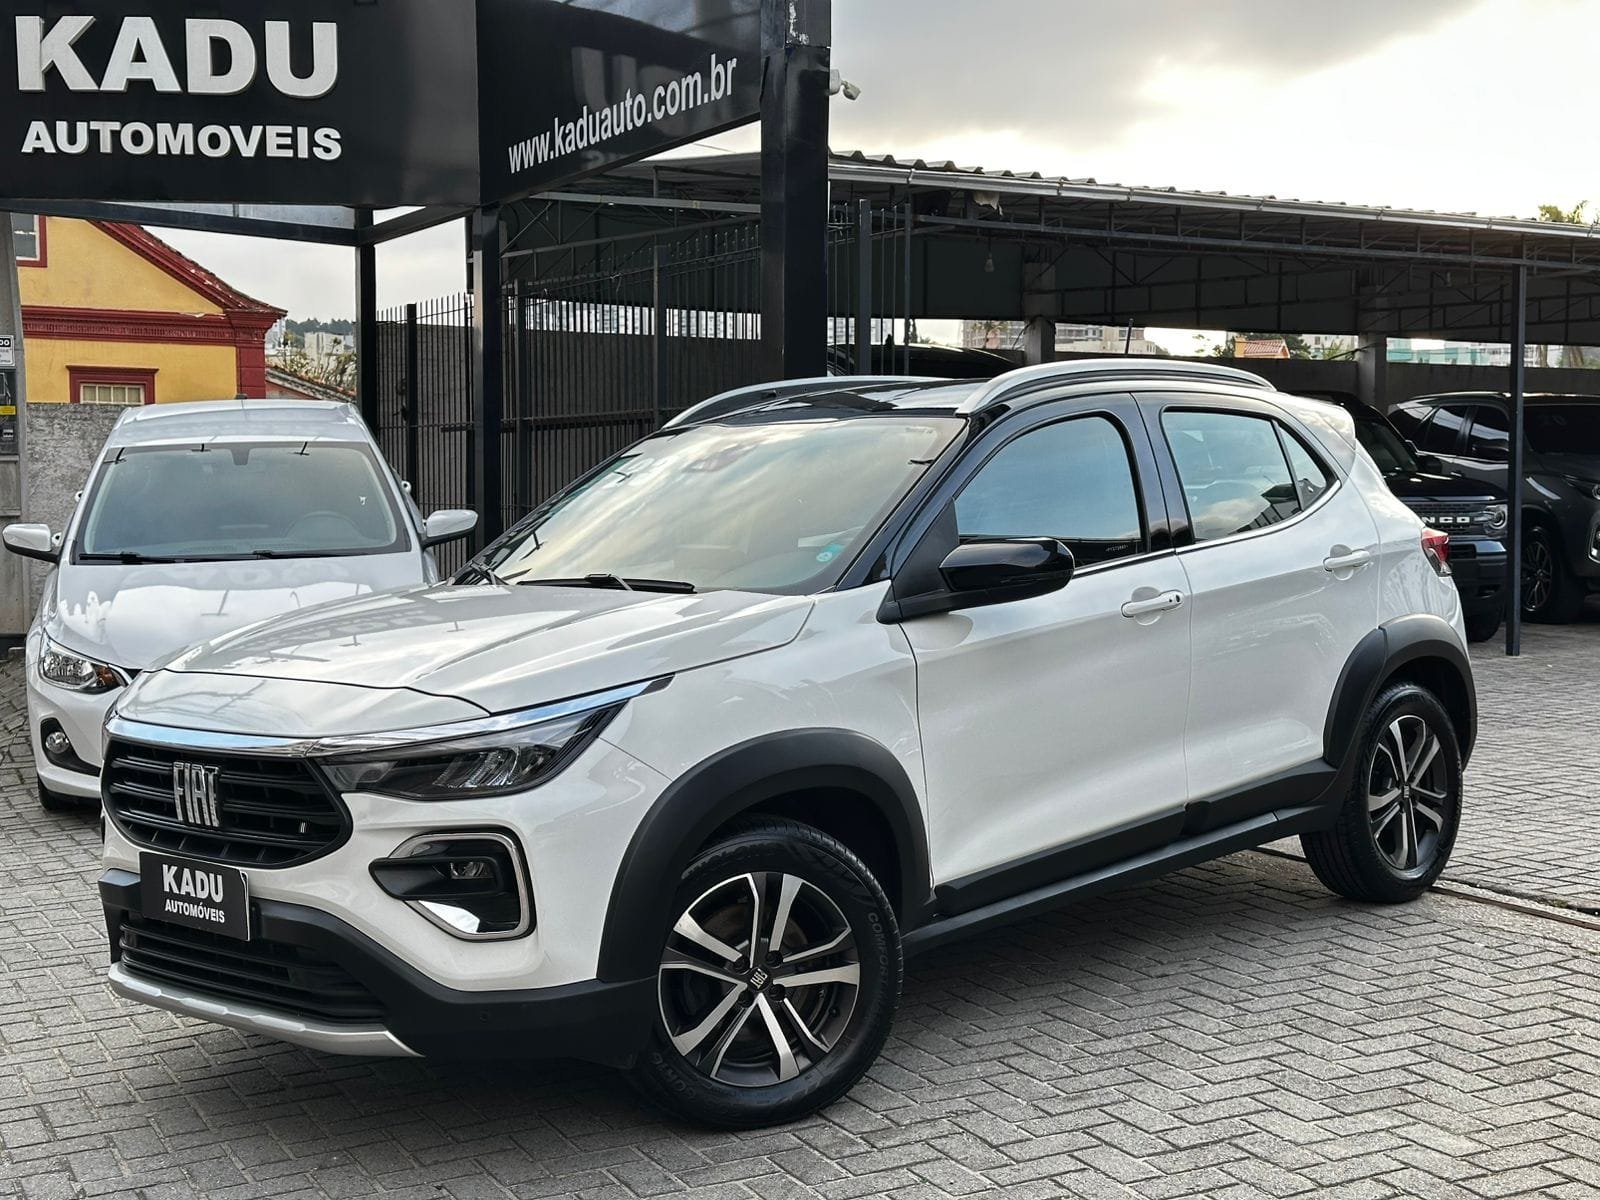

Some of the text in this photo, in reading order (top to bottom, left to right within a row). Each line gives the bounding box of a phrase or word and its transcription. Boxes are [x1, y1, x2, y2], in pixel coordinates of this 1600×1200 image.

[15, 15, 338, 98] KADU
[21, 120, 343, 161] AUTOMOVEIS
[508, 53, 738, 174] www.kaduauto.com.br
[173, 761, 220, 828] FIAT
[162, 863, 224, 903] KADU
[164, 898, 226, 924] AUTOMÓVEIS
